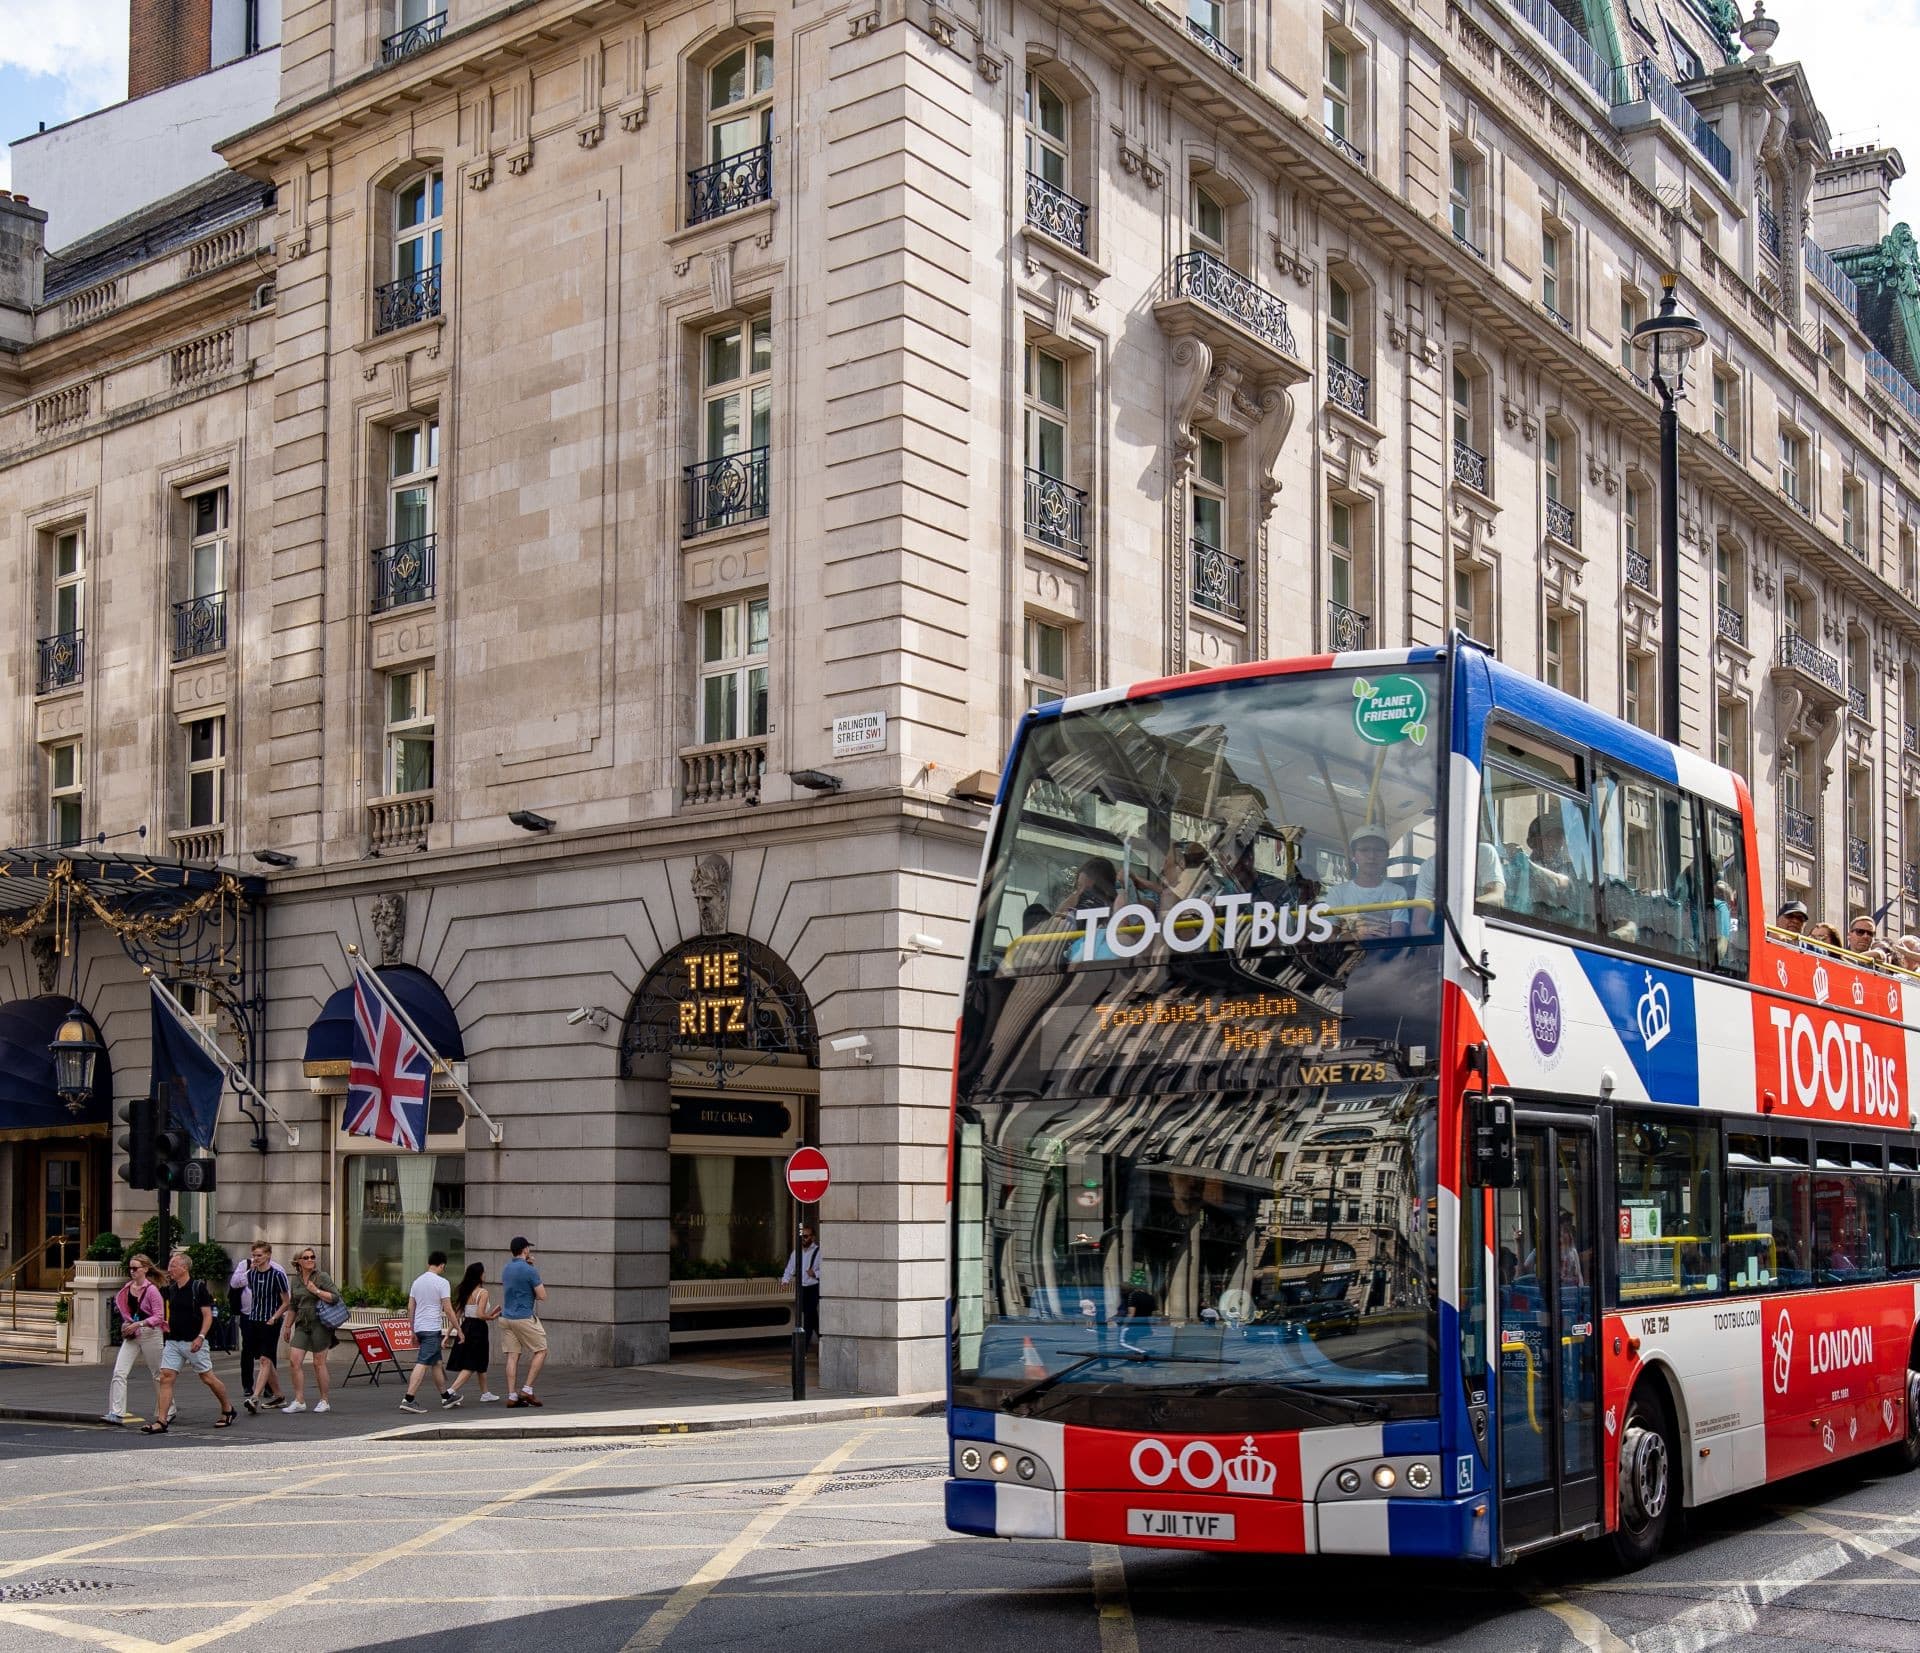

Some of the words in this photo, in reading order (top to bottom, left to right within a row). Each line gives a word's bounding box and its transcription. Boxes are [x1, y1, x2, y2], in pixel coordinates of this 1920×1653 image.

[1371, 694, 1413, 708] PLANET
[837, 716, 878, 731] ARLINGTON
[1363, 706, 1417, 722] FRIENDLY
[837, 730, 864, 744] STREET
[866, 727, 881, 740] SW1
[684, 952, 739, 990] THE
[679, 997, 745, 1035] RITZ
[1095, 1002, 1198, 1031] Tootbus
[1204, 994, 1298, 1024] London
[1224, 1025, 1272, 1051] Hop
[1281, 1026, 1313, 1046] on
[1321, 1018, 1340, 1047] H
[1300, 1063, 1344, 1084] VXE
[1350, 1061, 1387, 1082] 725
[1641, 1317, 1657, 1336] VXE
[1658, 1315, 1670, 1334] 725
[1713, 1309, 1761, 1332] TOOTBUS.COM
[1808, 1325, 1873, 1375] LONDON
[1142, 1512, 1177, 1535] YJ11
[1182, 1514, 1220, 1537] TVF
